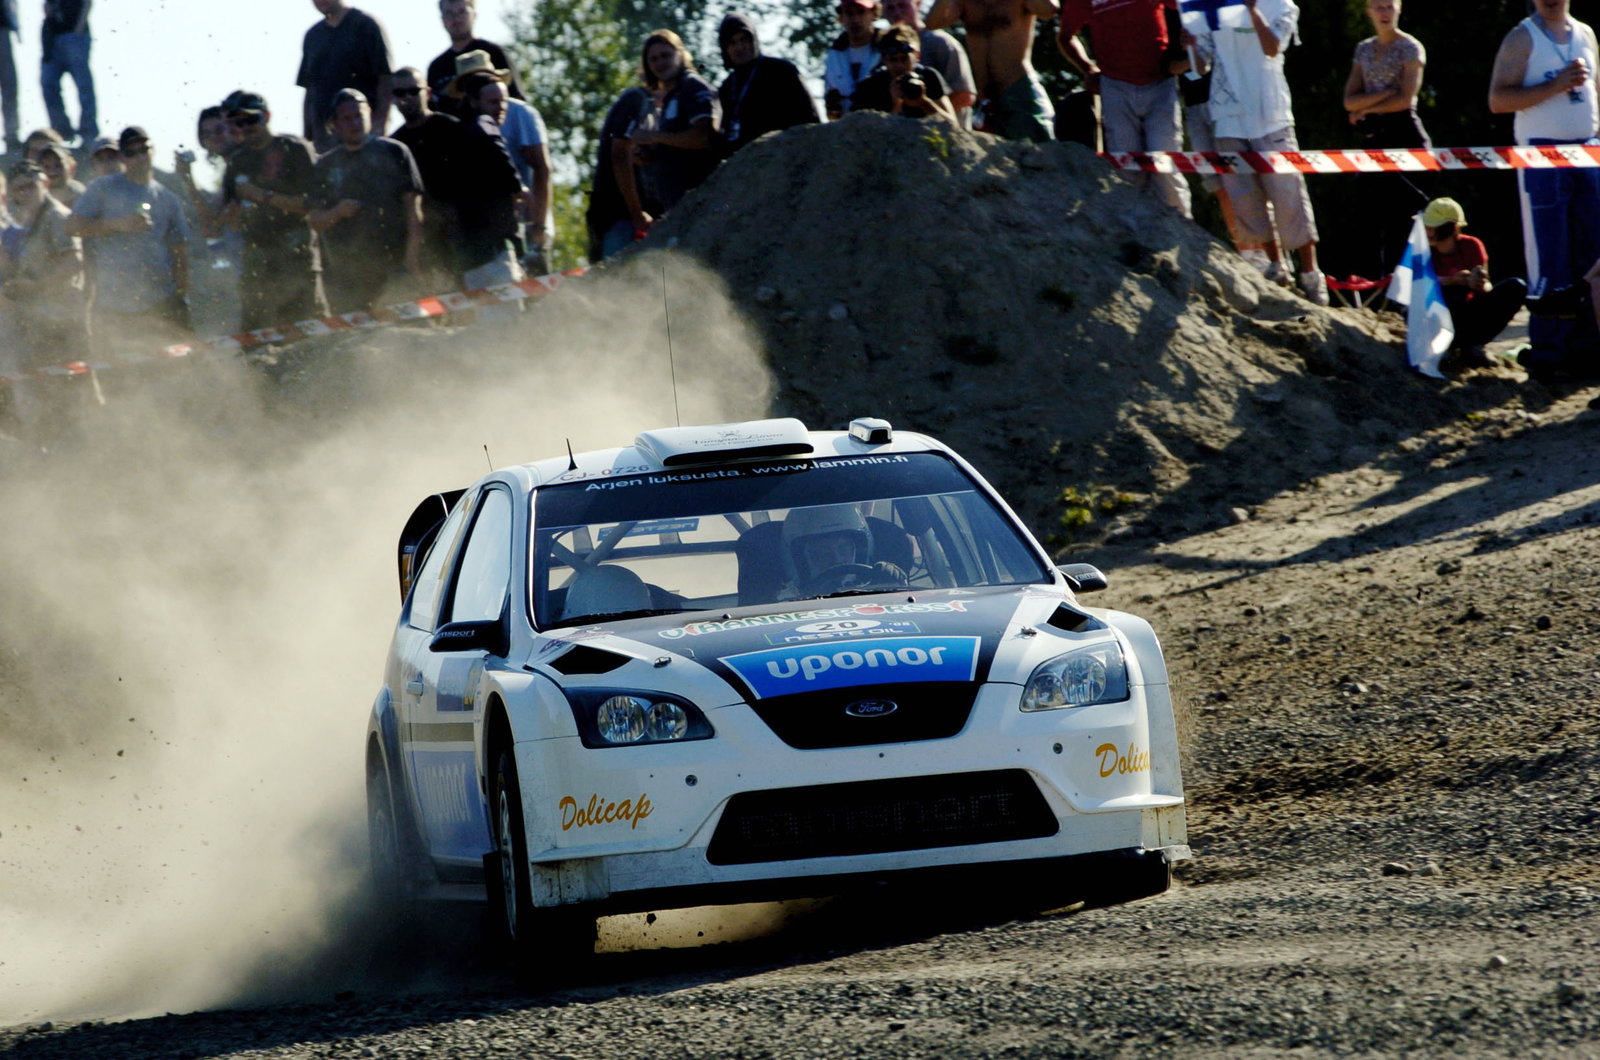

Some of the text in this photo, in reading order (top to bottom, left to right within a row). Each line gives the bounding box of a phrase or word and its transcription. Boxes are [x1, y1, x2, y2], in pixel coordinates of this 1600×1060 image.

[585, 478, 643, 492] Arjen
[752, 455, 909, 475] www.lammin.fi
[816, 621, 859, 631] 20
[869, 627, 904, 635] OIL
[766, 645, 948, 681] uponor
[558, 792, 655, 832] Dolicap
